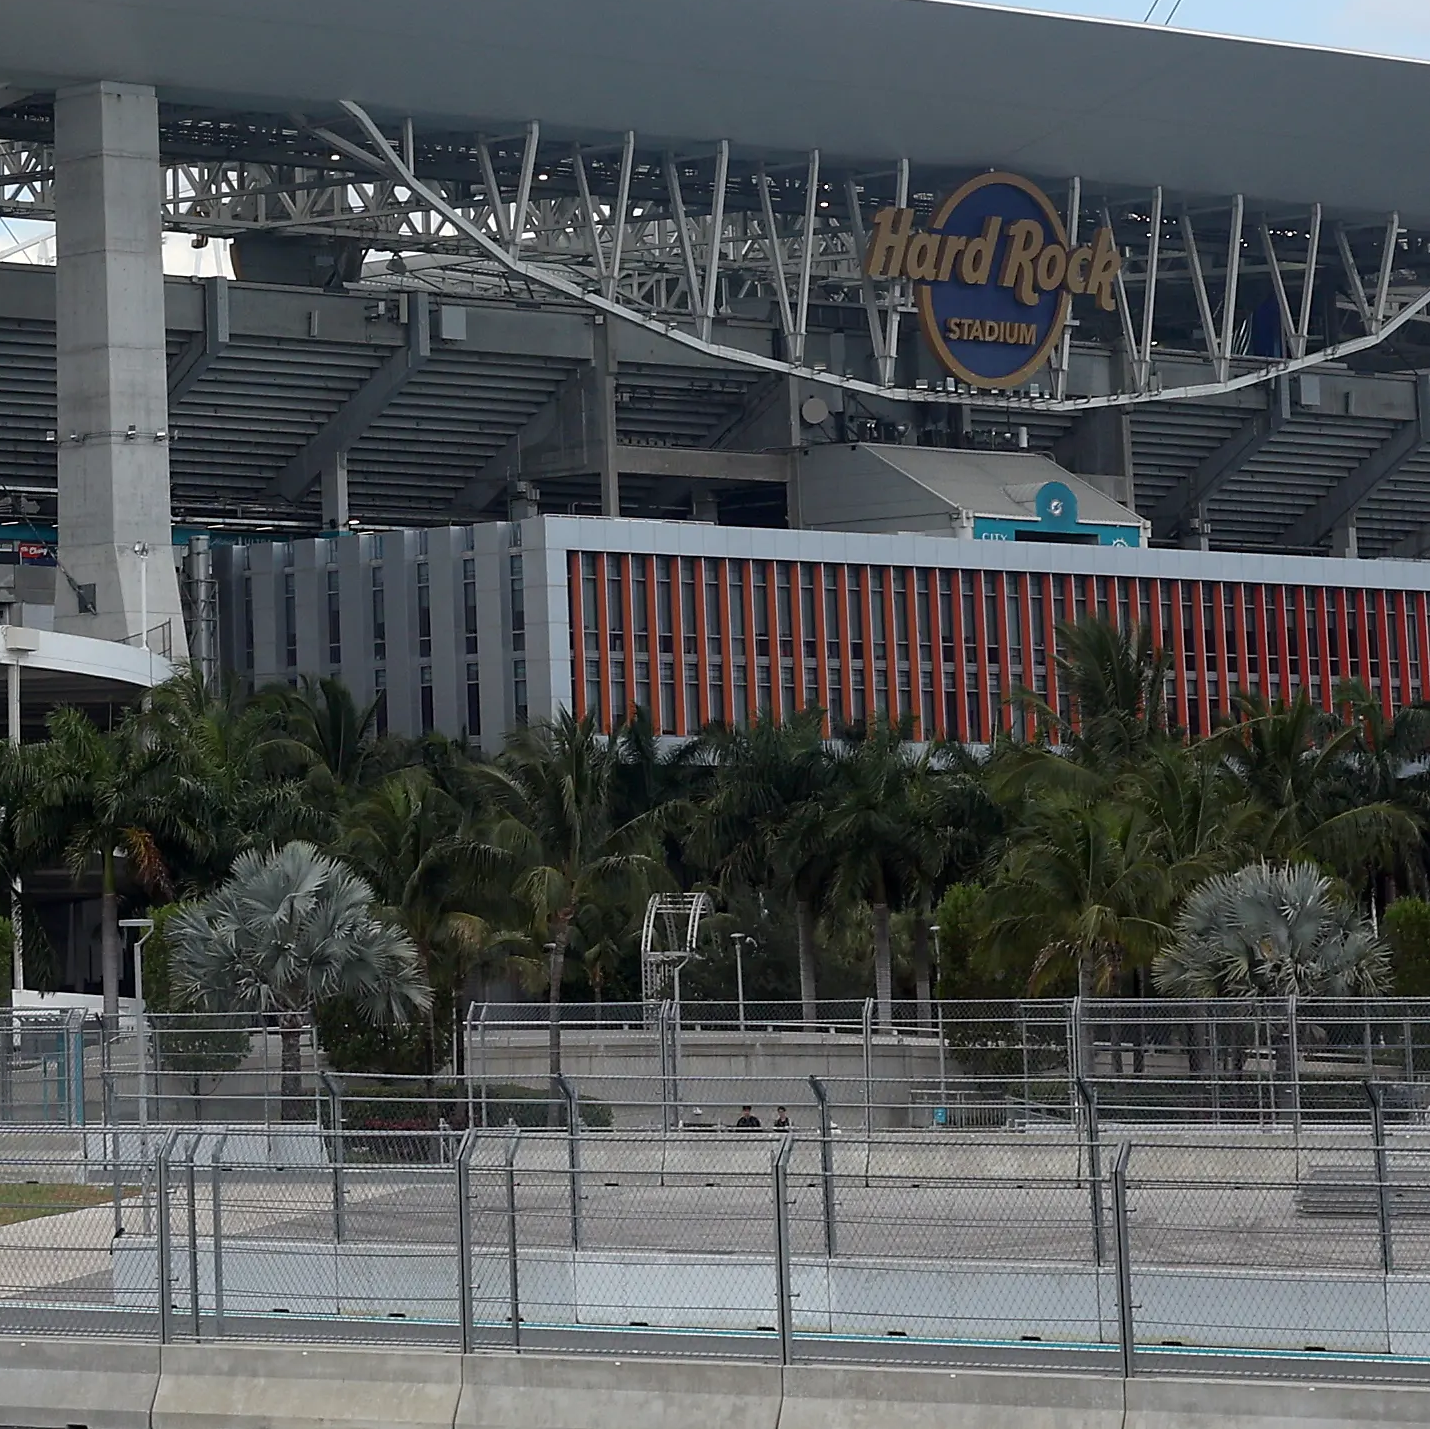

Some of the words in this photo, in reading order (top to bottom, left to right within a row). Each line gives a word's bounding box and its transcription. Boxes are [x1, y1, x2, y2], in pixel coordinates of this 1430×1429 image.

[868, 207, 1002, 284] Hard
[998, 218, 1122, 311] Rock
[946, 317, 1037, 346] STADIUM
